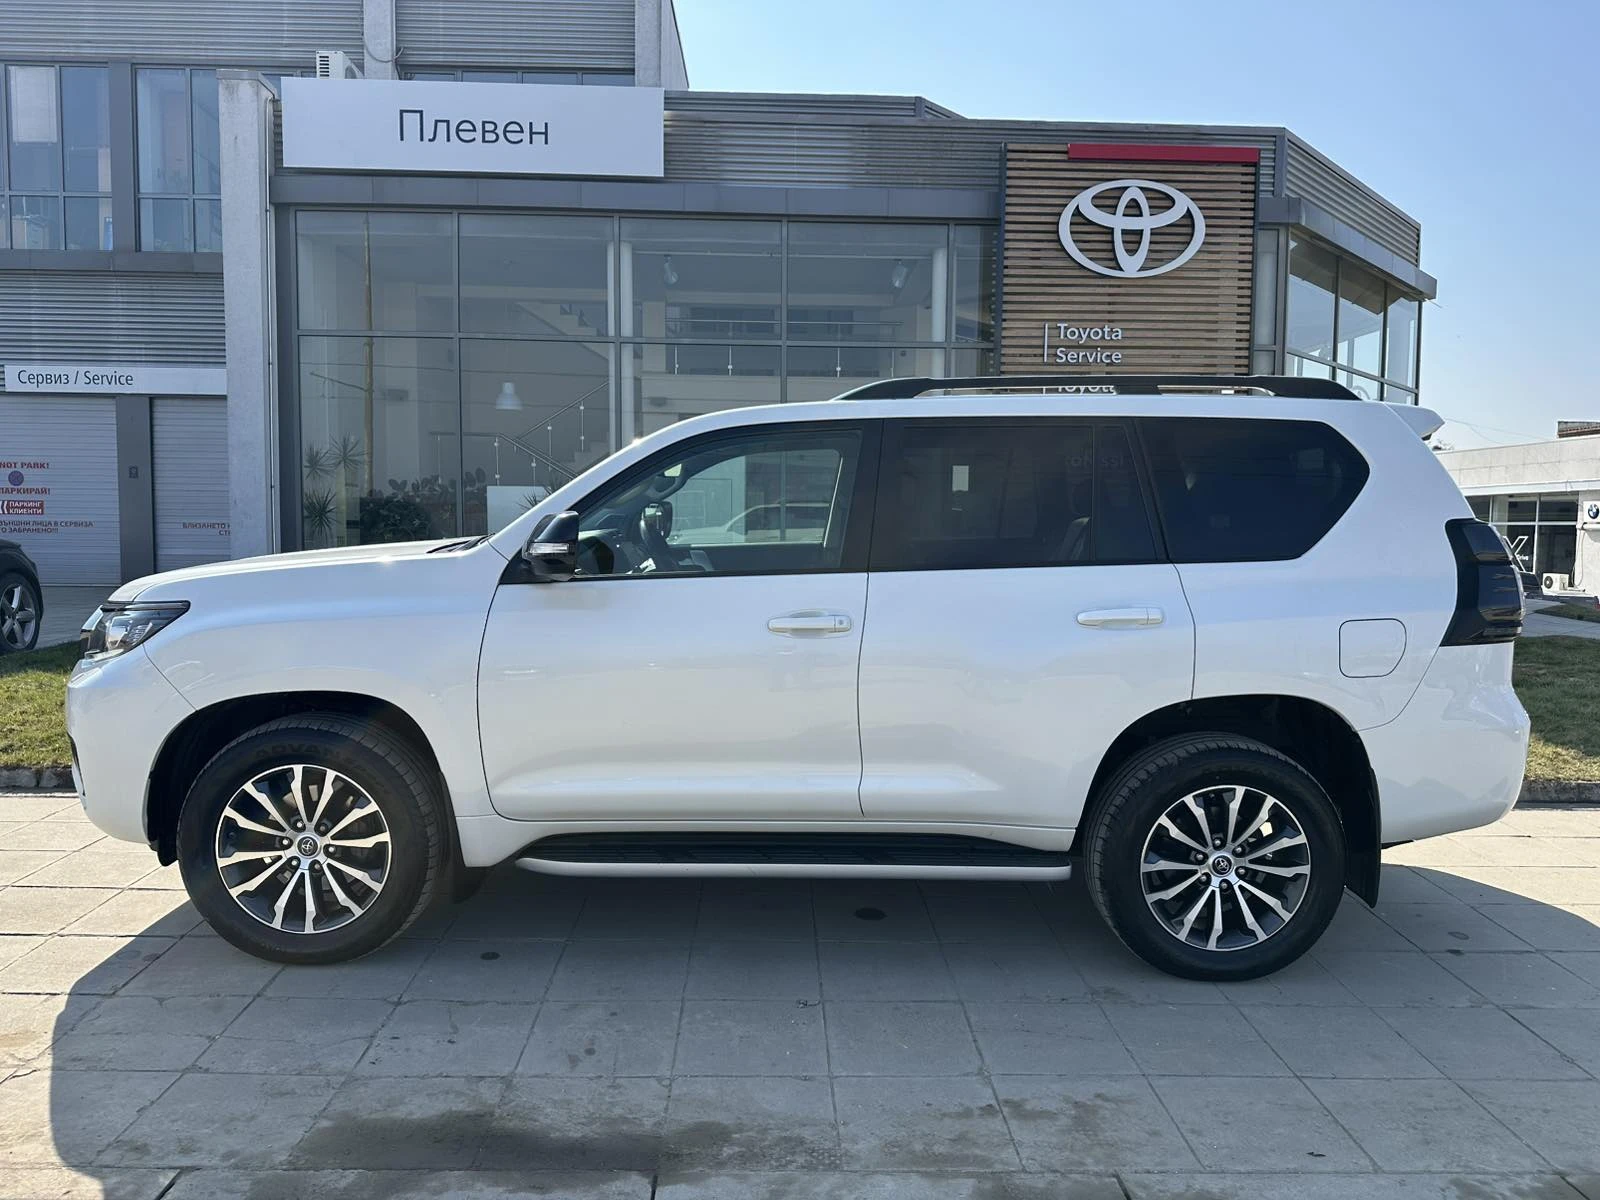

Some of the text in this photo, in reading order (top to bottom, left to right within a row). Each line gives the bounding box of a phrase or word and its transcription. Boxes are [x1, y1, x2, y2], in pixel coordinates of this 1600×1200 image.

[399, 109, 549, 145] Плевен
[1056, 323, 1122, 344] Toyota
[1055, 347, 1122, 363] Service
[17, 369, 134, 388] Сервиз / Service
